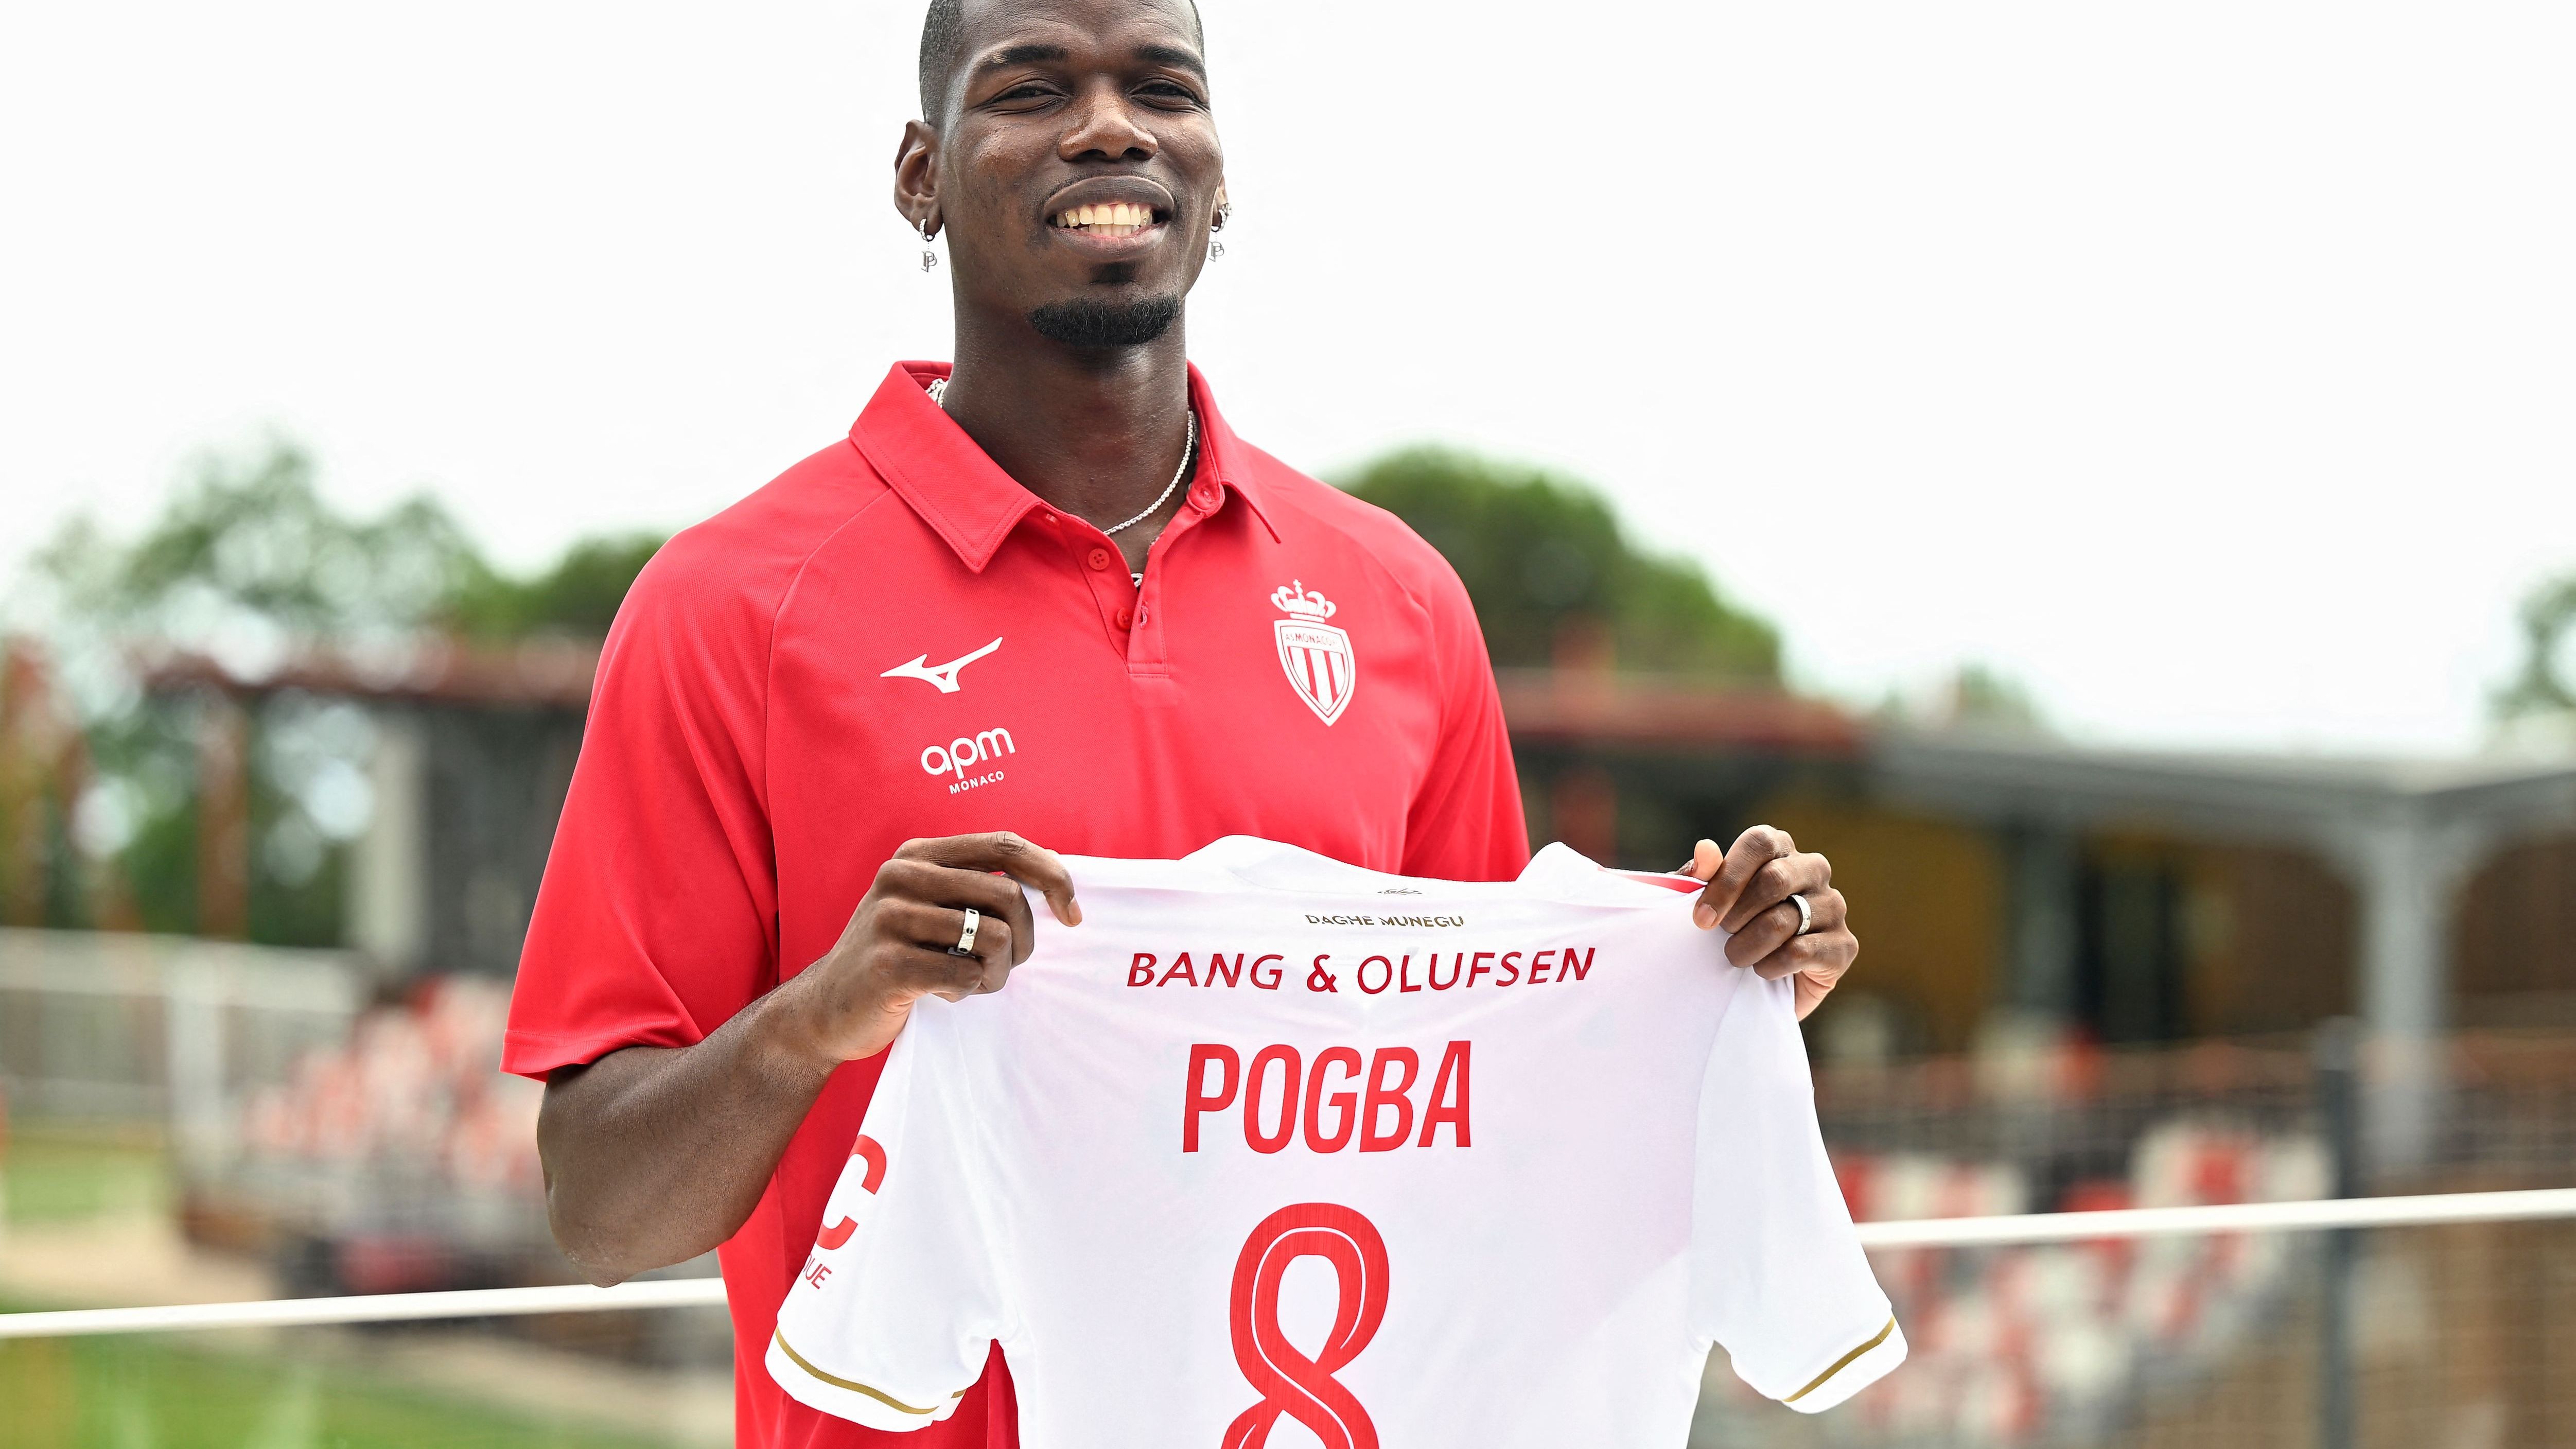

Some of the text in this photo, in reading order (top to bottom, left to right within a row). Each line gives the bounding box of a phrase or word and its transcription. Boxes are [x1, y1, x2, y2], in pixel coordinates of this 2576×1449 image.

[921, 727, 1016, 779] apm
[949, 771, 1004, 795] MONACO
[1305, 915, 1464, 927] DAGHE MUNEGU
[1127, 947, 1596, 994] BANG & OLUFSEN
[1182, 1040, 1471, 1155] POGBA
[1219, 1202, 1390, 1449] 8
